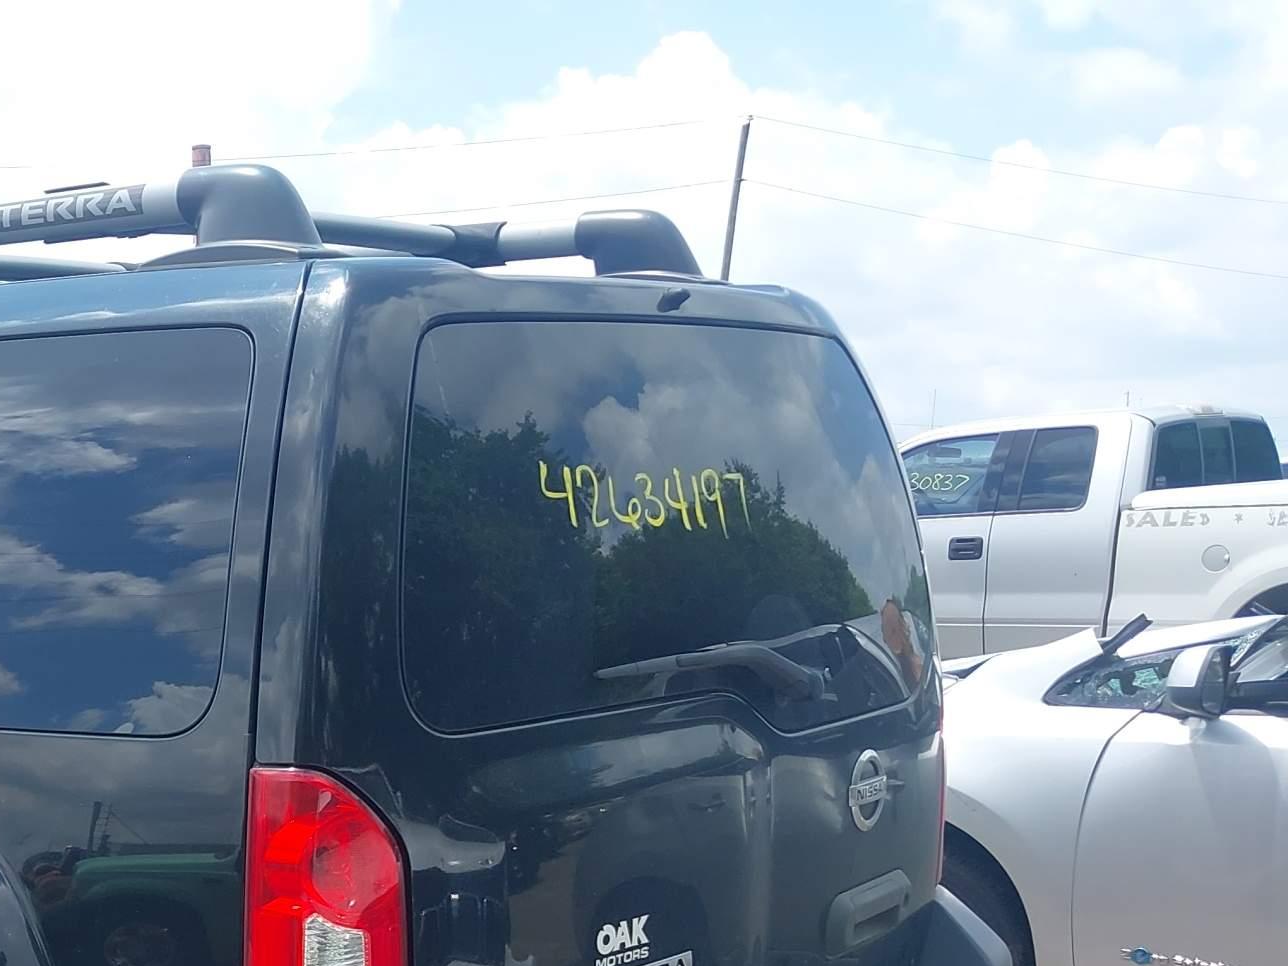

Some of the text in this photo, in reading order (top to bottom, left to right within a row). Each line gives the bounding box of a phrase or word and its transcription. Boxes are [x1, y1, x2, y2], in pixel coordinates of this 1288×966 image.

[538, 460, 753, 540] 42634197
[856, 782, 883, 801] NISS
[596, 914, 650, 955] OAK
